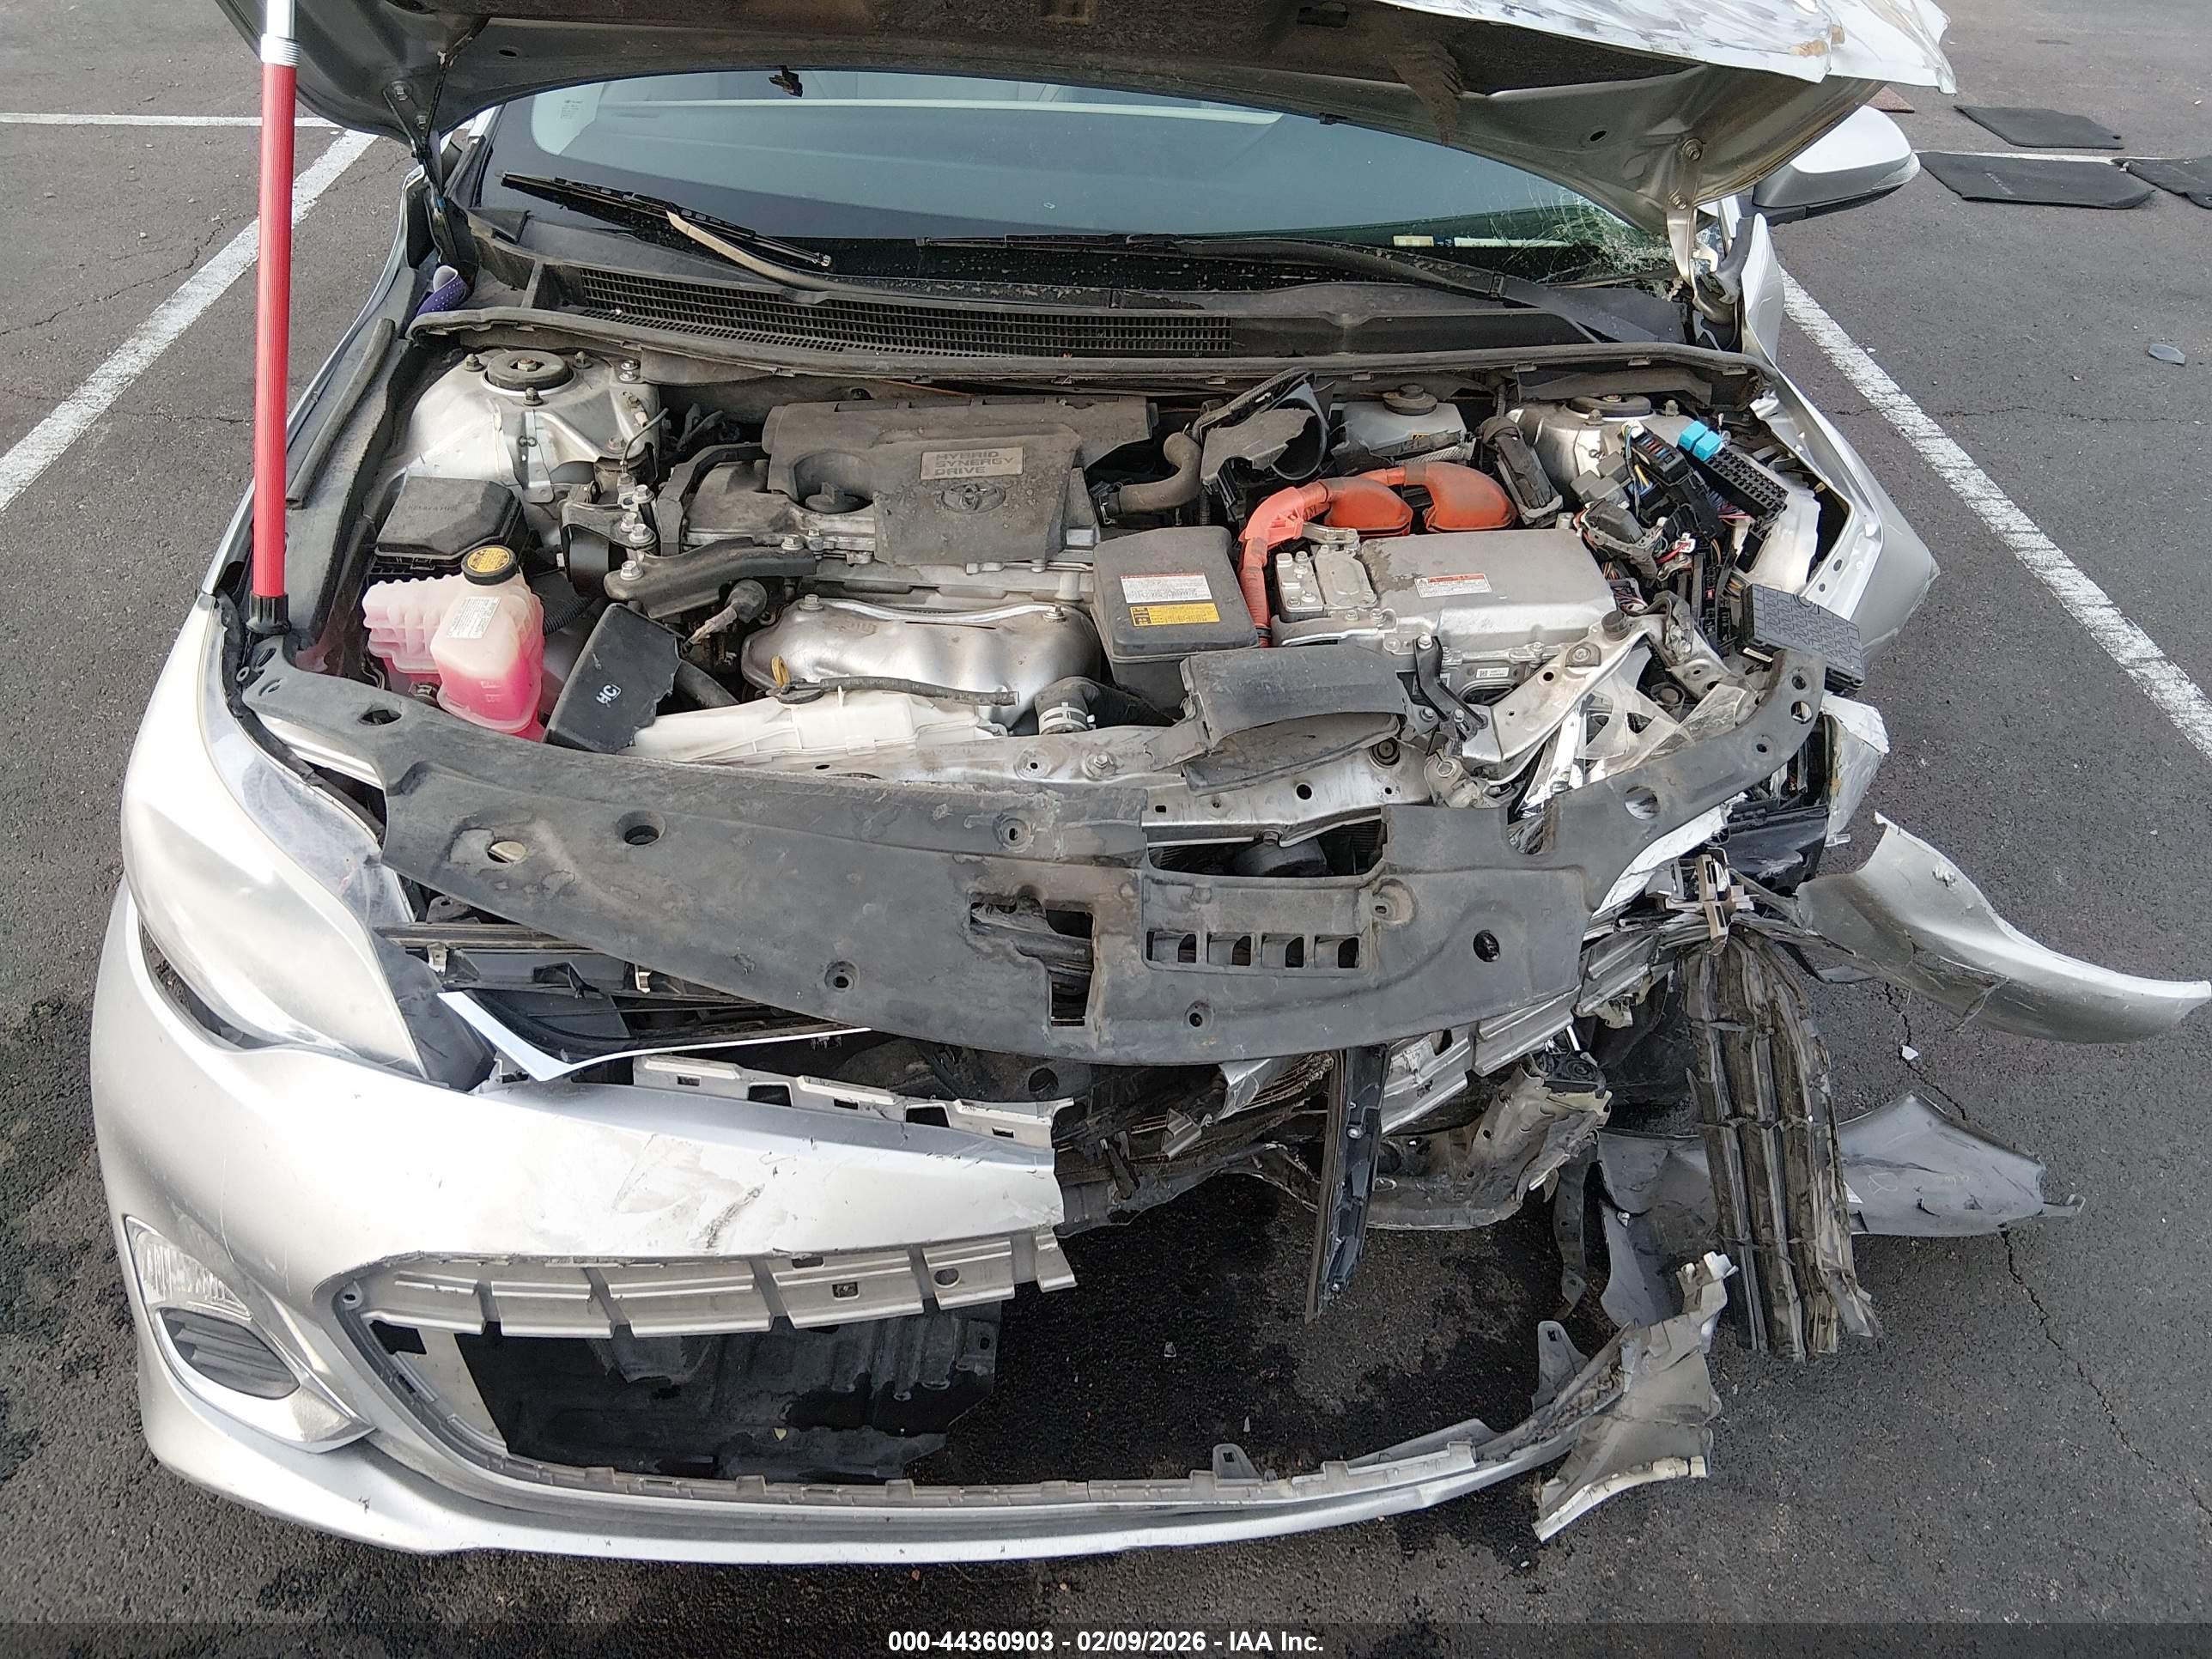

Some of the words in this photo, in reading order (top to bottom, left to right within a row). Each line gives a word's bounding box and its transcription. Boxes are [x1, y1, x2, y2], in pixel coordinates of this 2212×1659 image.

[935, 451, 999, 461] HYBRID
[935, 457, 1014, 468] SYNERGY
[934, 466, 986, 476] DRIVE
